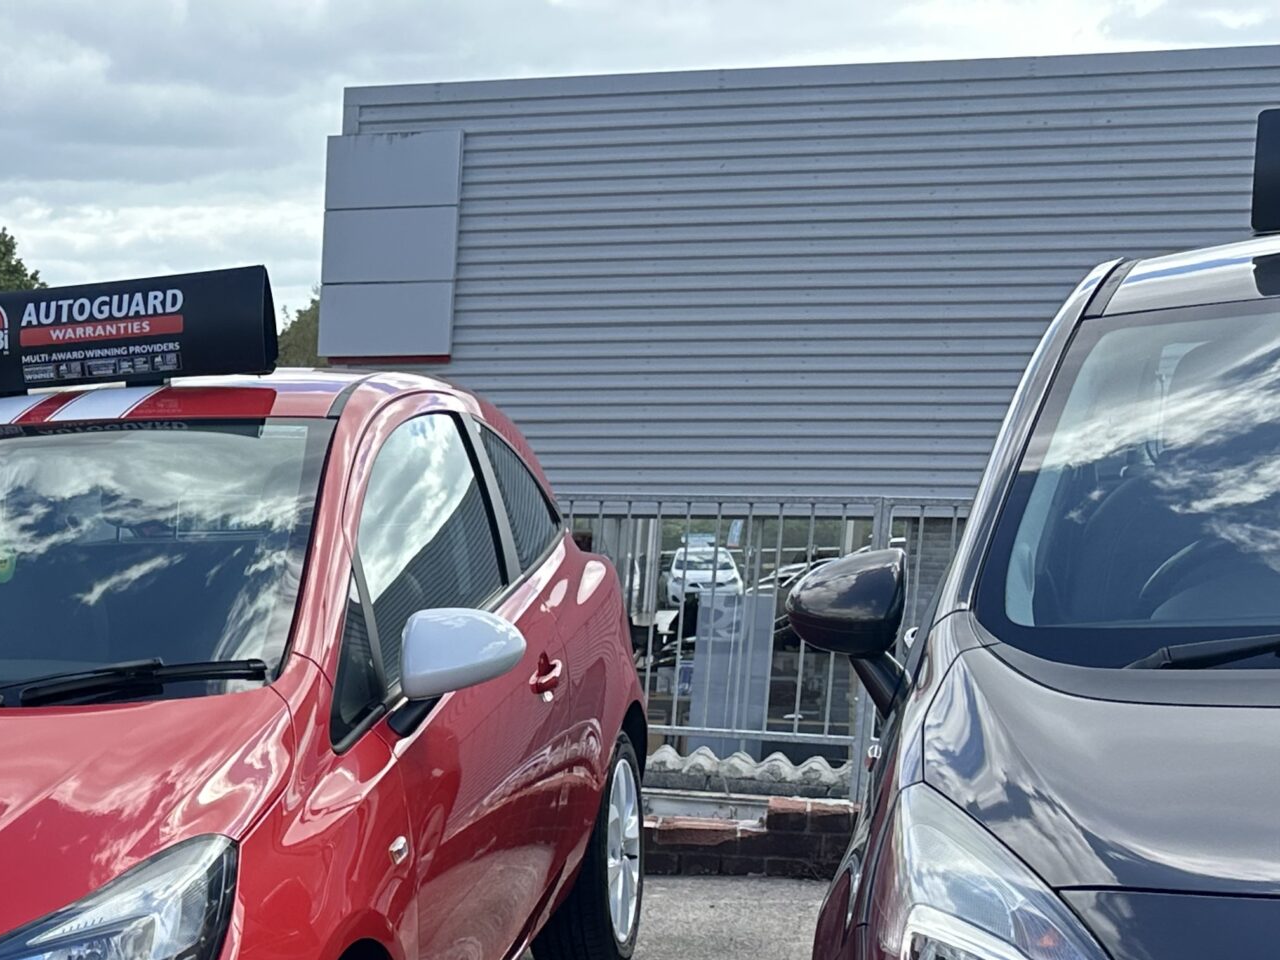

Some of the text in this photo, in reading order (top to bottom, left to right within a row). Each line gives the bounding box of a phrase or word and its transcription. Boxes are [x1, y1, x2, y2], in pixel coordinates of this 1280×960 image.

[21, 288, 184, 327] AUTOGUARD
[49, 321, 151, 341] WARRANTIES
[85, 347, 127, 358] WINNING
[129, 342, 181, 354] PROVIDERS
